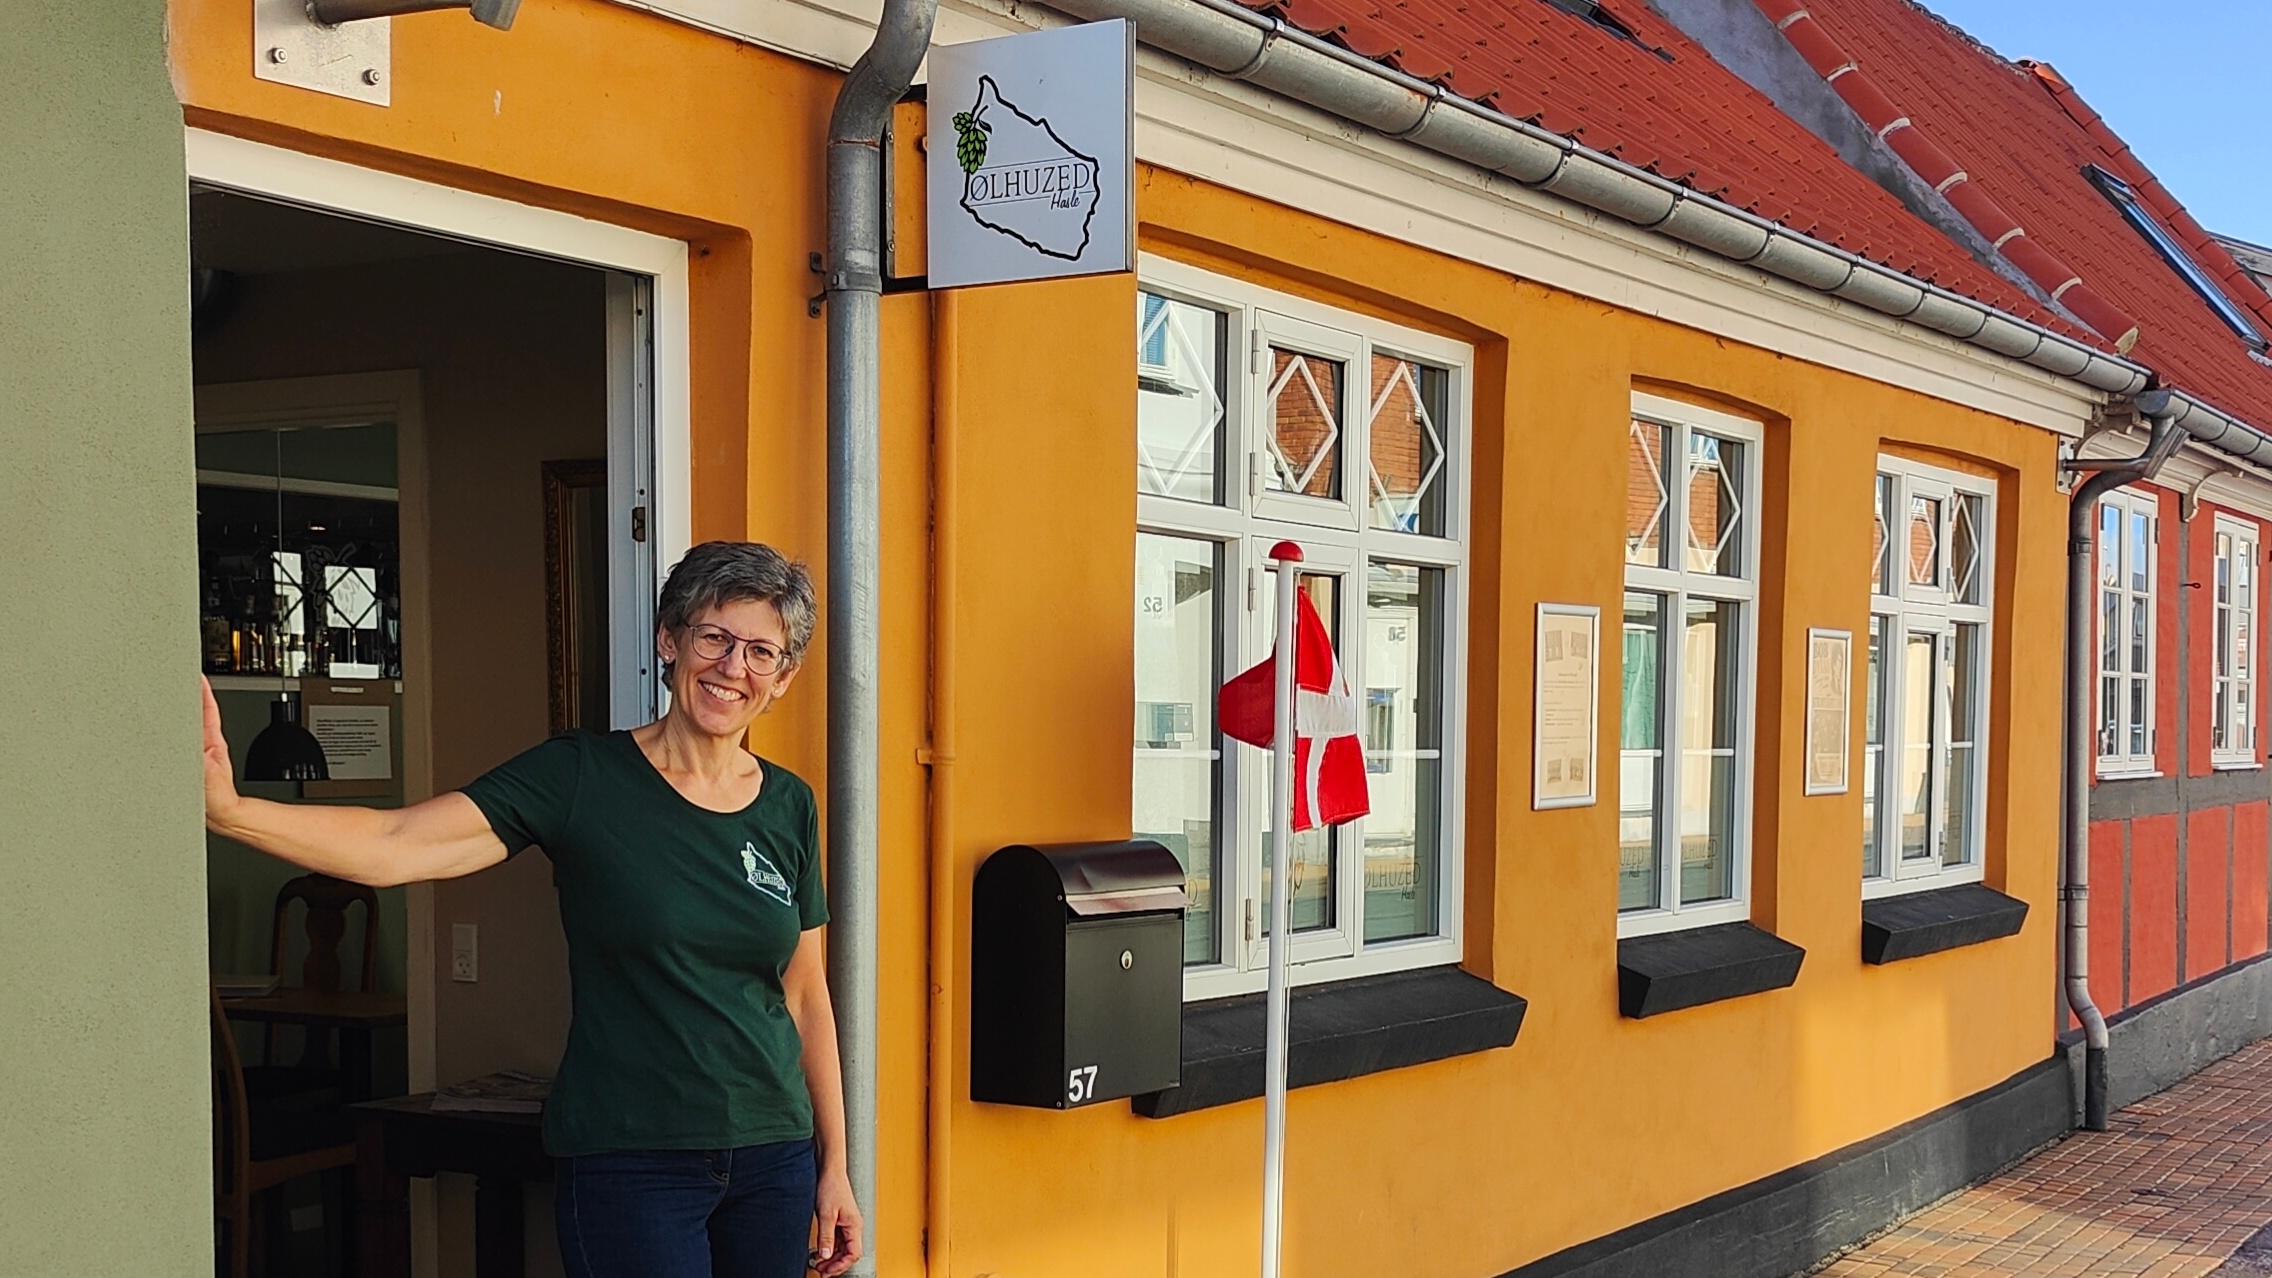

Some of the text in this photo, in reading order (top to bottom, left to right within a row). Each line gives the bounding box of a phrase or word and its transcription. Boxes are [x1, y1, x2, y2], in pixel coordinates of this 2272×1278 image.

[970, 163, 1090, 202] ØLHUZED
[1051, 189, 1081, 211] Hasle
[1068, 1064, 1098, 1103] 57
